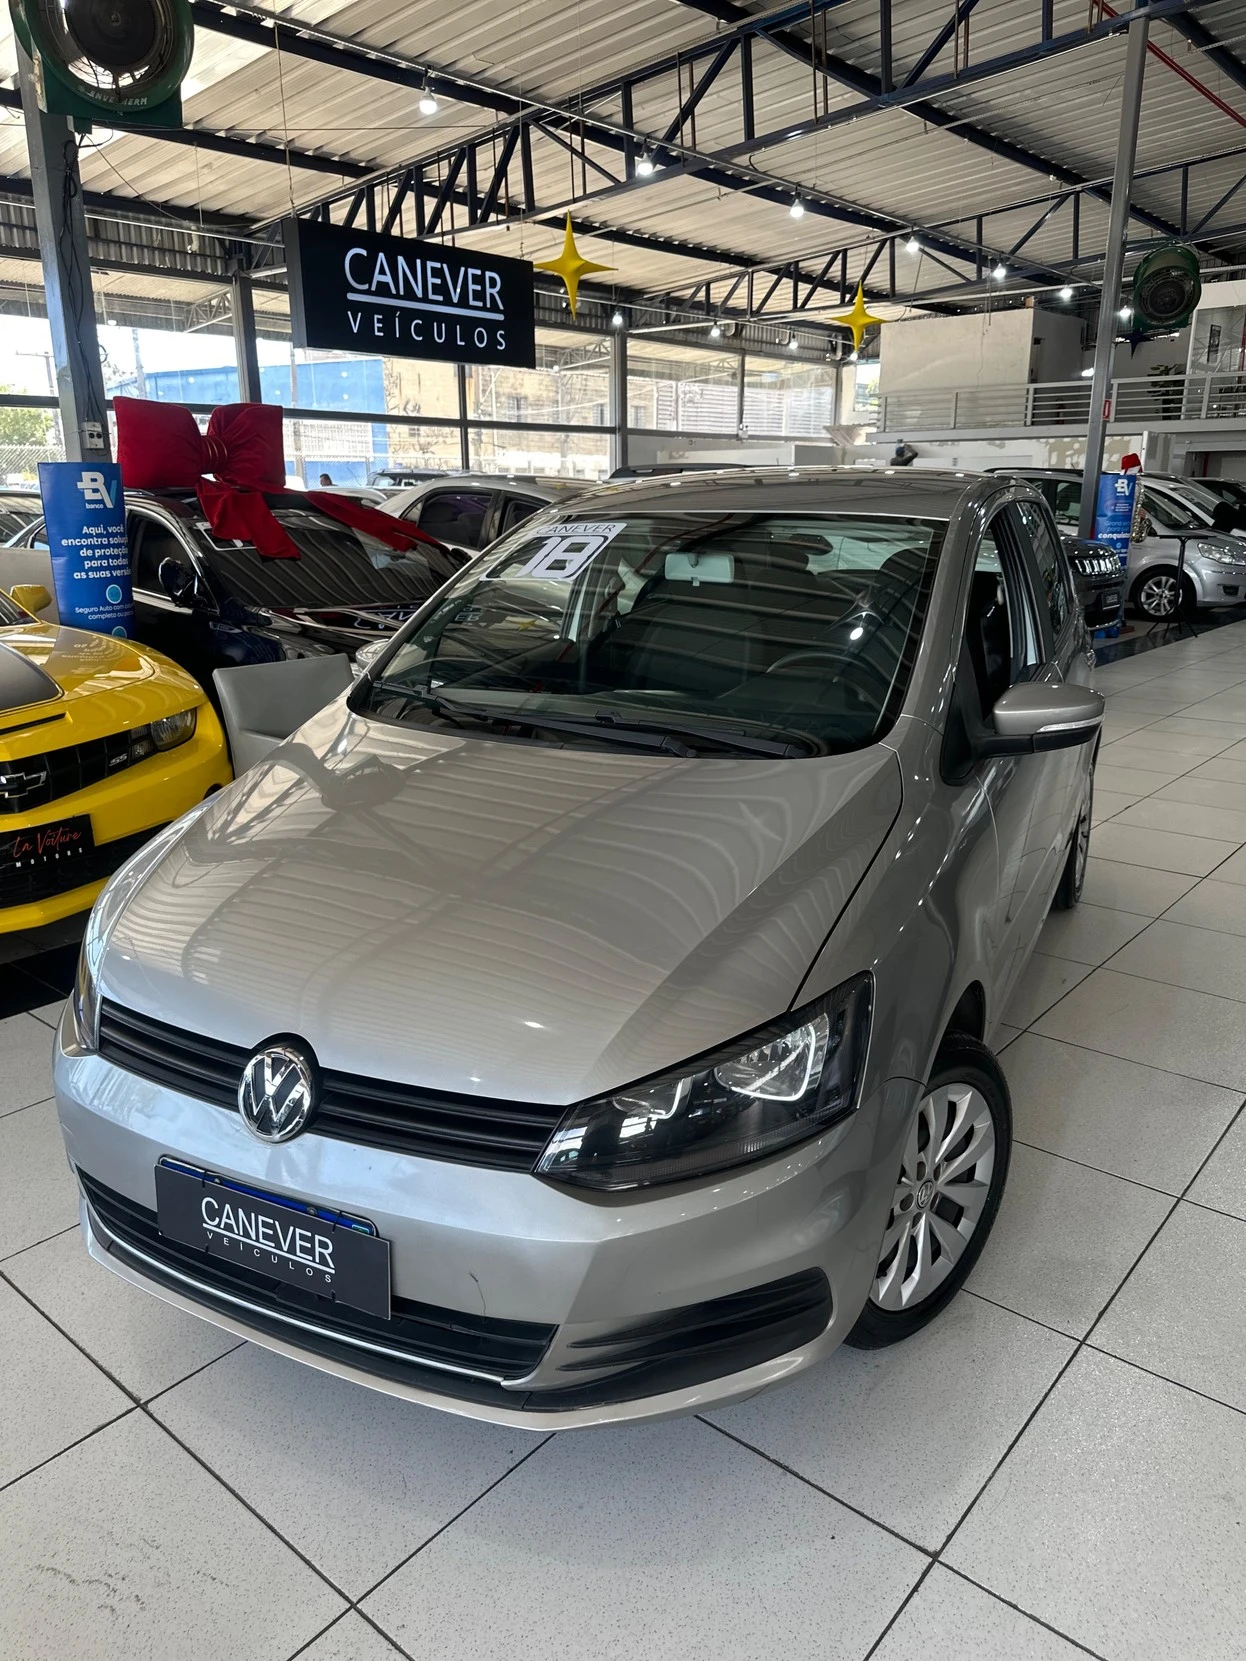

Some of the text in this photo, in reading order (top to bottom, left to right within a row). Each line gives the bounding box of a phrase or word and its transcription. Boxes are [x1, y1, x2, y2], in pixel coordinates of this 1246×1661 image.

[90, 90, 148, 106] ENVEHERM
[344, 247, 505, 311] CANEVER
[347, 311, 507, 351] VEÍCULOS
[77, 471, 118, 509] BV
[82, 524, 107, 536] Aqui,
[536, 523, 617, 536] CANEVER
[61, 536, 109, 546] encontra
[80, 547, 94, 557] de
[514, 536, 605, 578] 18
[84, 559, 108, 570] para
[73, 571, 88, 580] as
[88, 570, 111, 579] suas
[74, 606, 99, 614] Seguro
[88, 612, 117, 620] completa
[13, 827, 82, 858] La Voiture
[15, 847, 83, 868] MOTORS
[201, 1196, 336, 1269] CANEVER
[206, 1231, 333, 1284] VEICULOS
